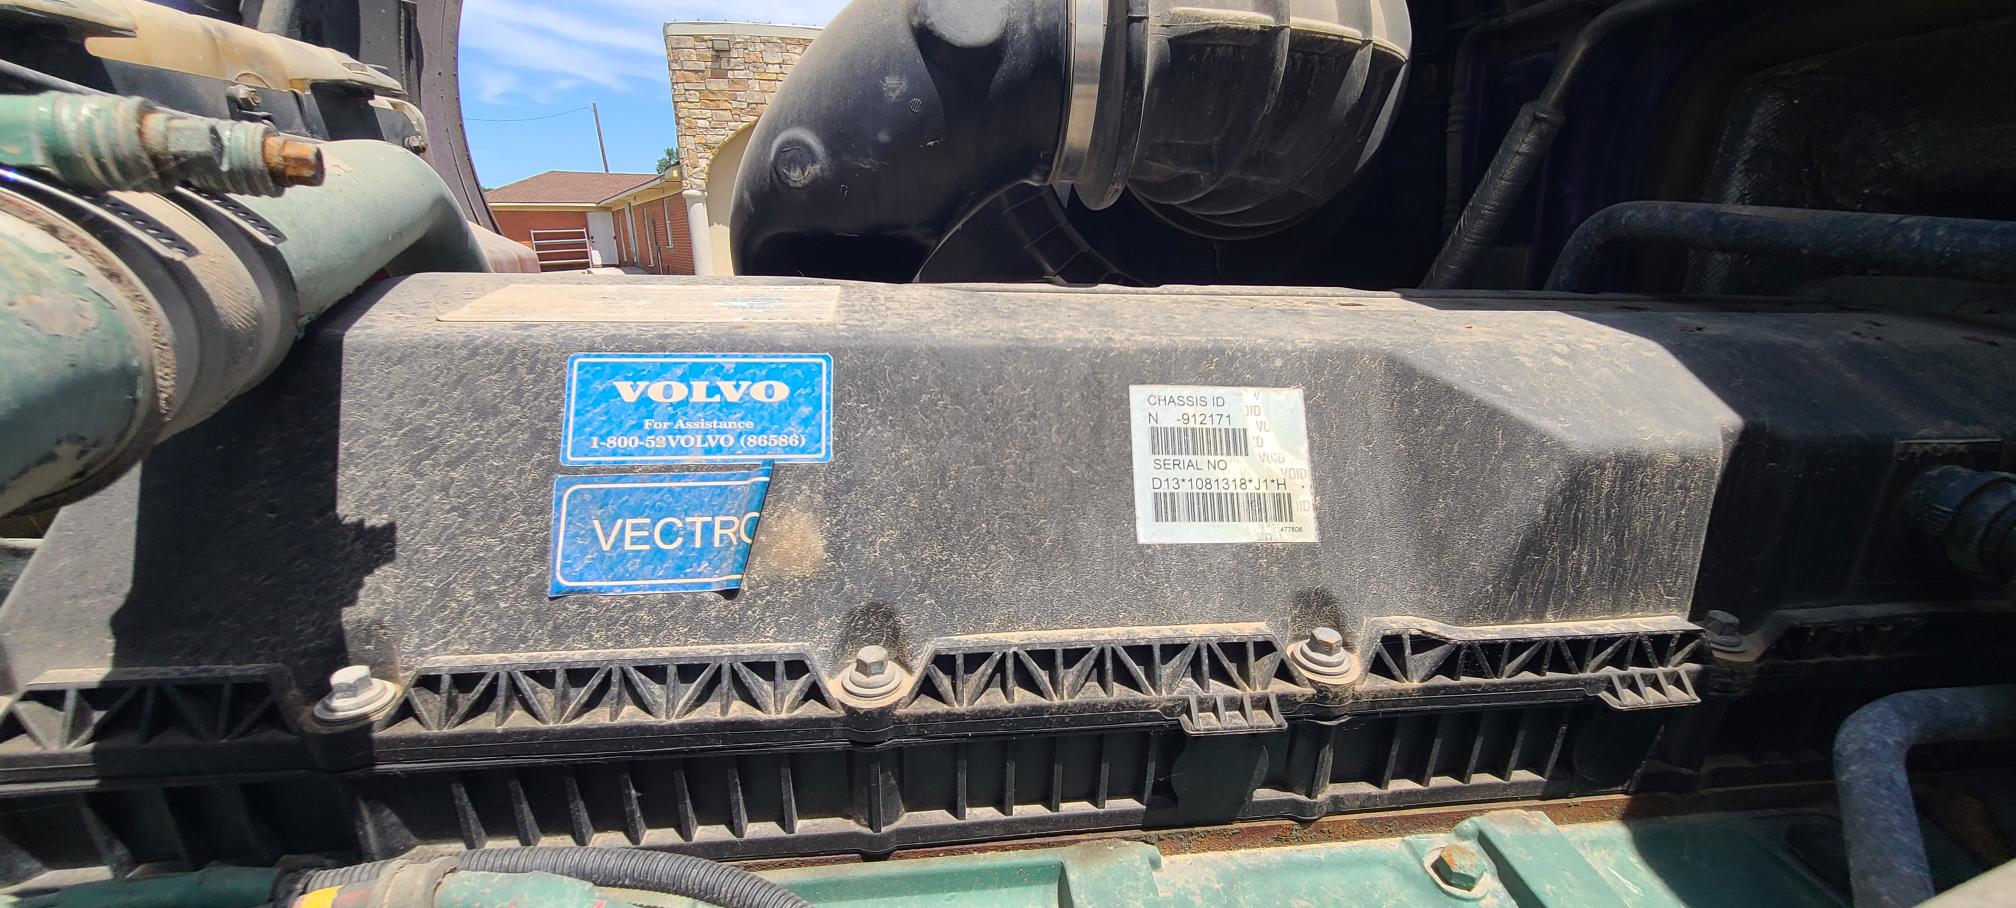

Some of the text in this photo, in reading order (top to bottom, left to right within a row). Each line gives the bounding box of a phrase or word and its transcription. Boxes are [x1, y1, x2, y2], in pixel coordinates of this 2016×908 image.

[614, 380, 790, 403] VOLVO
[1147, 394, 1225, 407] CHASSIS ID
[644, 419, 754, 430] For Assistance
[1148, 412, 1232, 425] N -912171
[590, 434, 806, 449] 1-800-52VOLVO (86586)
[1153, 459, 1228, 471] SERIAL NO
